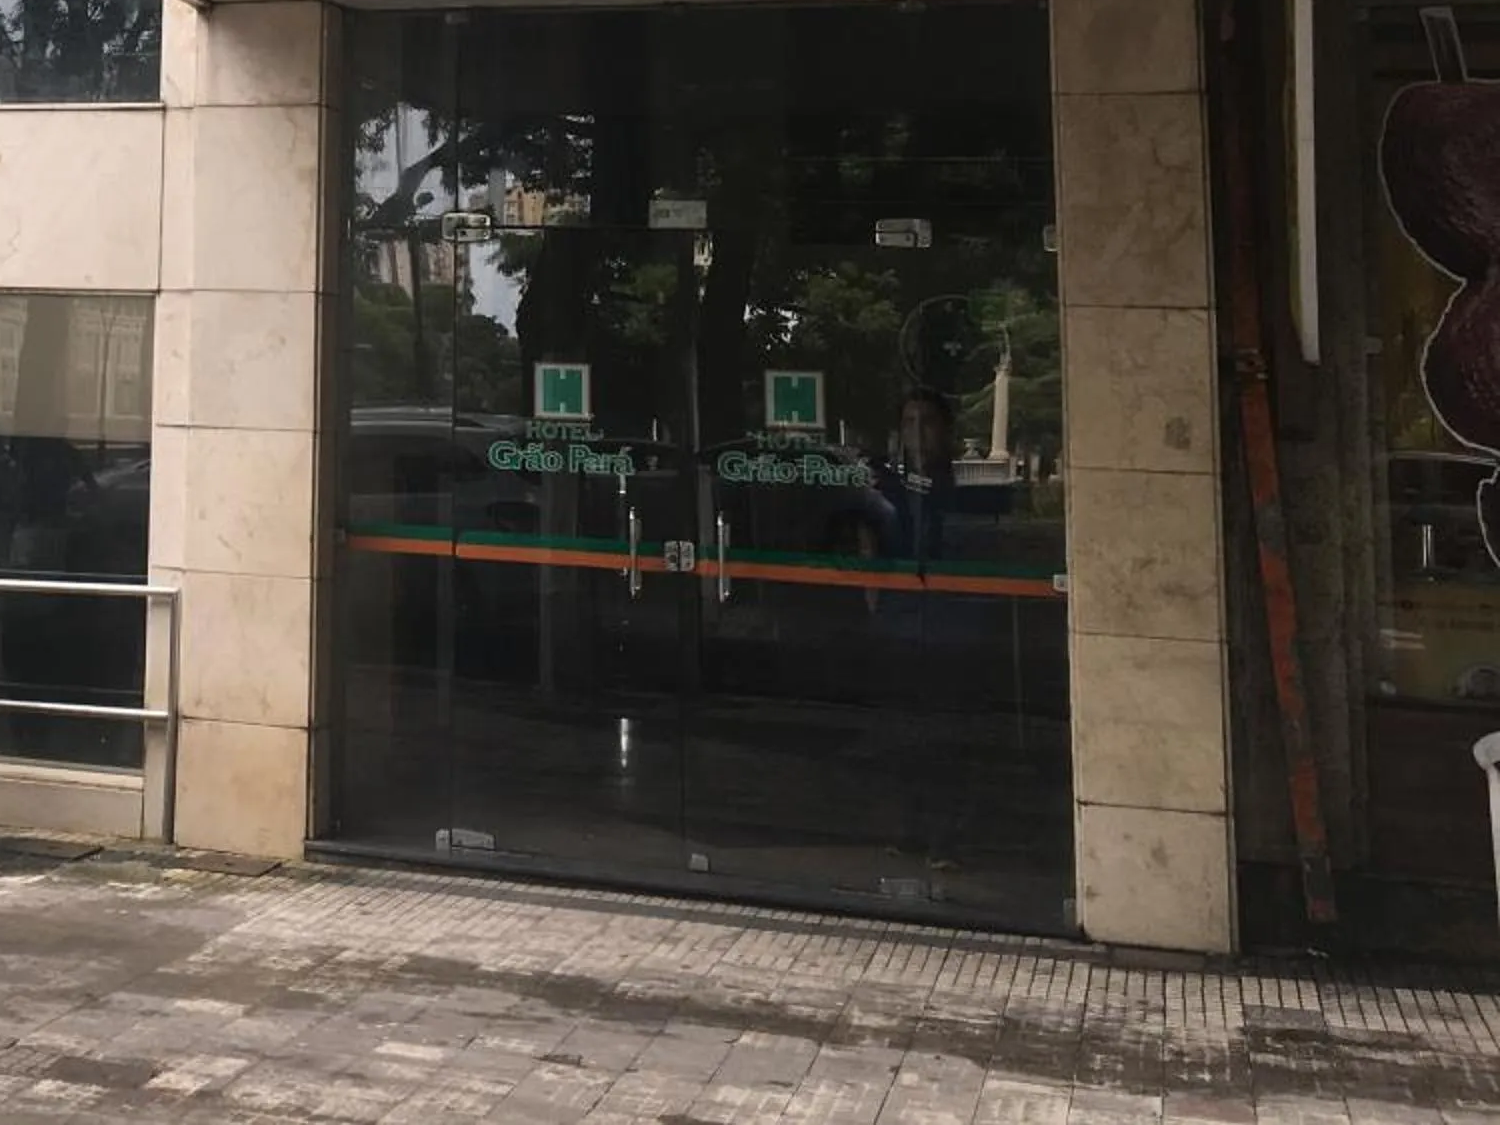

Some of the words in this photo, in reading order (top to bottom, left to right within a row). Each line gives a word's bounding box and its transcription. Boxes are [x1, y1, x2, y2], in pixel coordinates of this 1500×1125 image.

[525, 420, 604, 441] HOTEL
[488, 440, 564, 472] Grão
[569, 445, 636, 475] Pará
